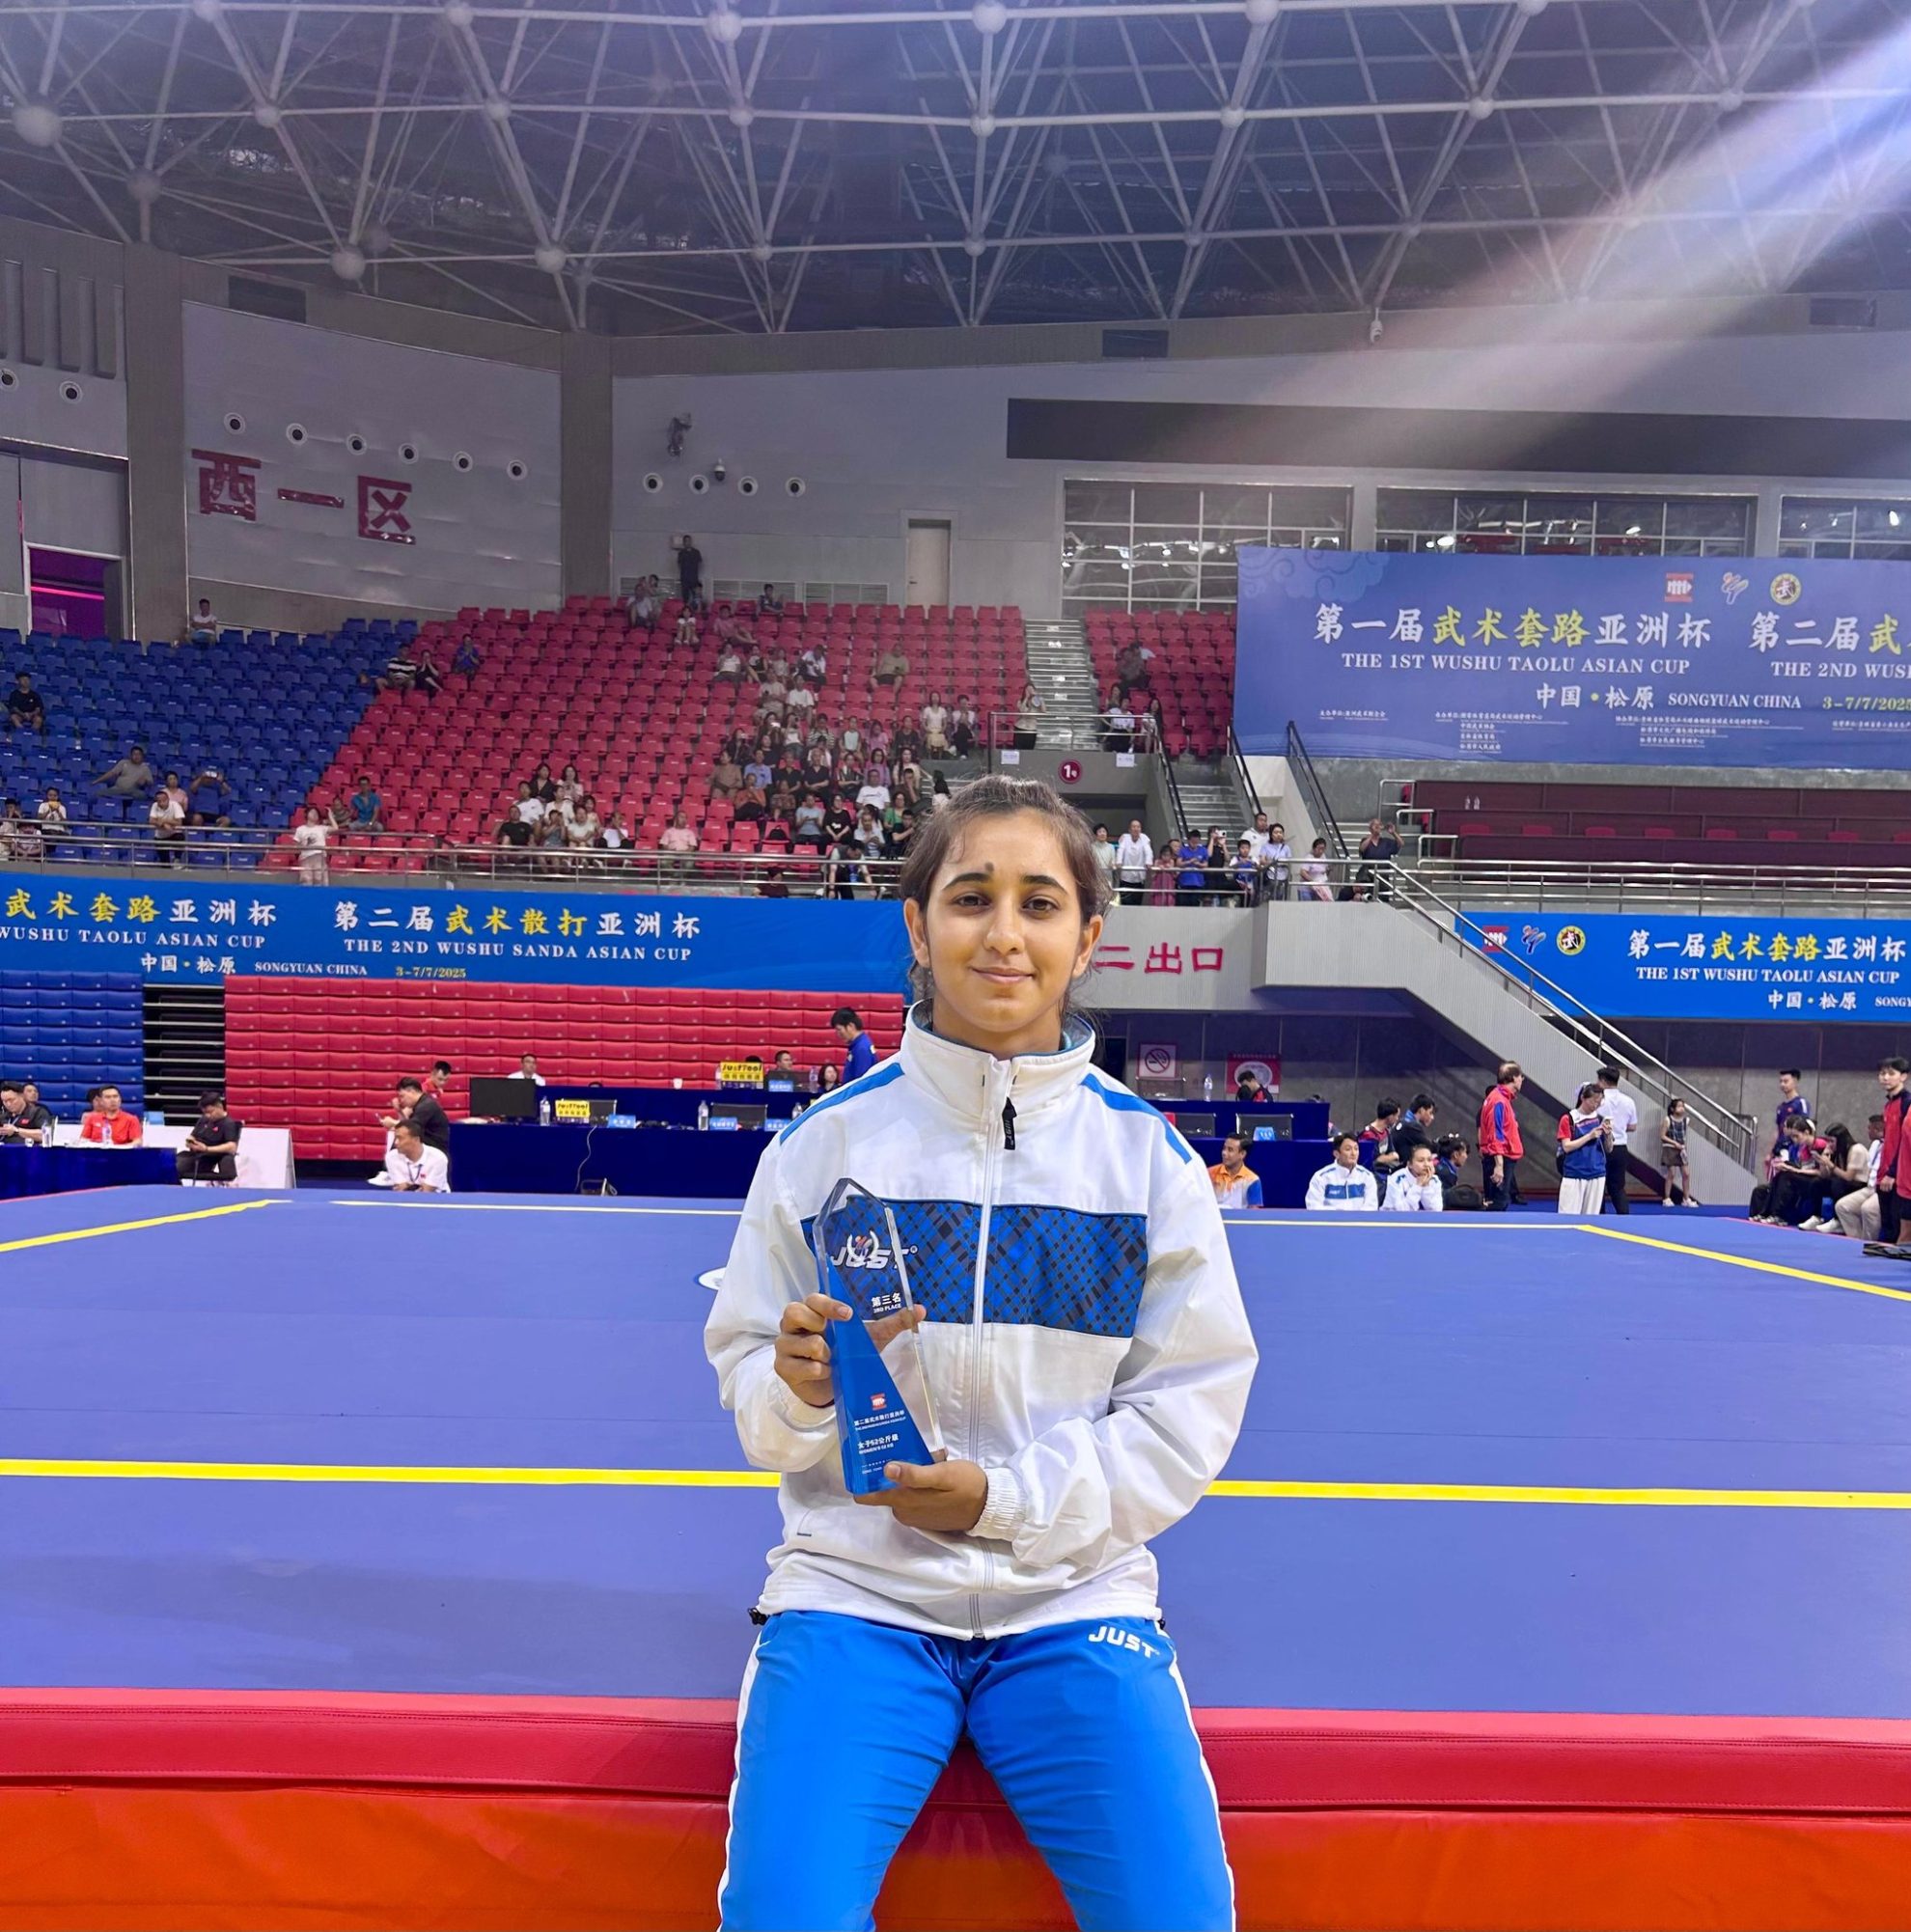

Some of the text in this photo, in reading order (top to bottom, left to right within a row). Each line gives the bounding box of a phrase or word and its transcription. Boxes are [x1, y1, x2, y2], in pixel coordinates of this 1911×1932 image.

[192, 449, 416, 545] 西一区
[1314, 603, 1711, 649] 第一届武术套路亚洲杯
[1749, 611, 1911, 655] 第二届武
[1342, 652, 1690, 675] THE 1ST WUSHU TAOLU ASIAN CUP
[1771, 661, 1812, 676] THE
[1817, 662, 1858, 677] 2ND
[1668, 693, 1750, 707] SONGYUAN
[1753, 695, 1801, 708] CHINA
[5, 888, 277, 925] 武术套路亚洲杯
[334, 900, 701, 940] 第二届武术散打亚洲杯
[0, 925, 265, 949] WUSHU TAOLU ASIAN CUP
[344, 938, 692, 961] THE 2ND WUSHU SANDA ASIAN CUP
[1627, 928, 1906, 963] 第一届武术套路亚洲杯
[254, 961, 322, 975] SONGYUAN
[326, 963, 368, 976] CHINA
[1094, 942, 1223, 975] 二出口
[1636, 966, 1899, 984] THE 1ST WUSHU TAOLU ASIAN CUP
[872, 1292, 901, 1308] 第三名
[1088, 1626, 1153, 1659] JUST
